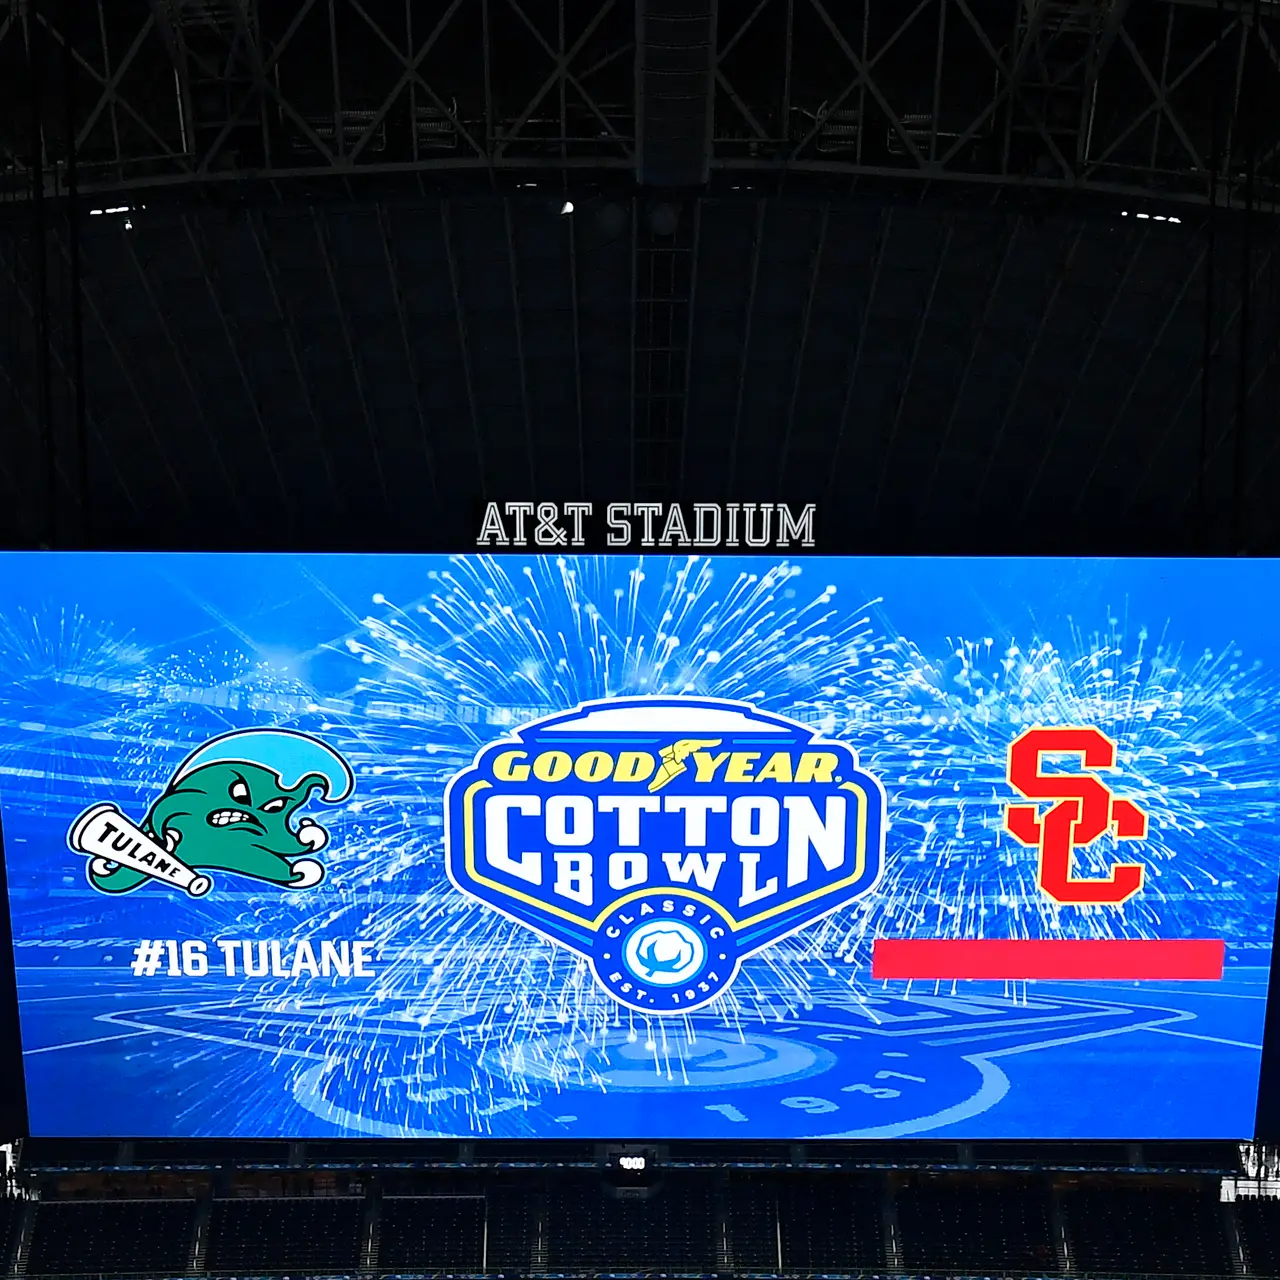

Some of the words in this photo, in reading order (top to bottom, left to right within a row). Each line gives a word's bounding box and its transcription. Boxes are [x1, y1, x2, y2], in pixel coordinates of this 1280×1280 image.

[476, 502, 592, 546] AT&T
[606, 502, 816, 547] STADIUM
[492, 744, 843, 790] GOODYEAR
[97, 821, 181, 878] TULANE
[484, 795, 846, 887] COTTON
[554, 853, 779, 907] BOWL
[607, 900, 725, 940] CLASSIC
[130, 939, 208, 977] #16
[216, 940, 376, 978] TULANE
[608, 973, 655, 1004] EST.
[672, 971, 721, 1004] 1937
